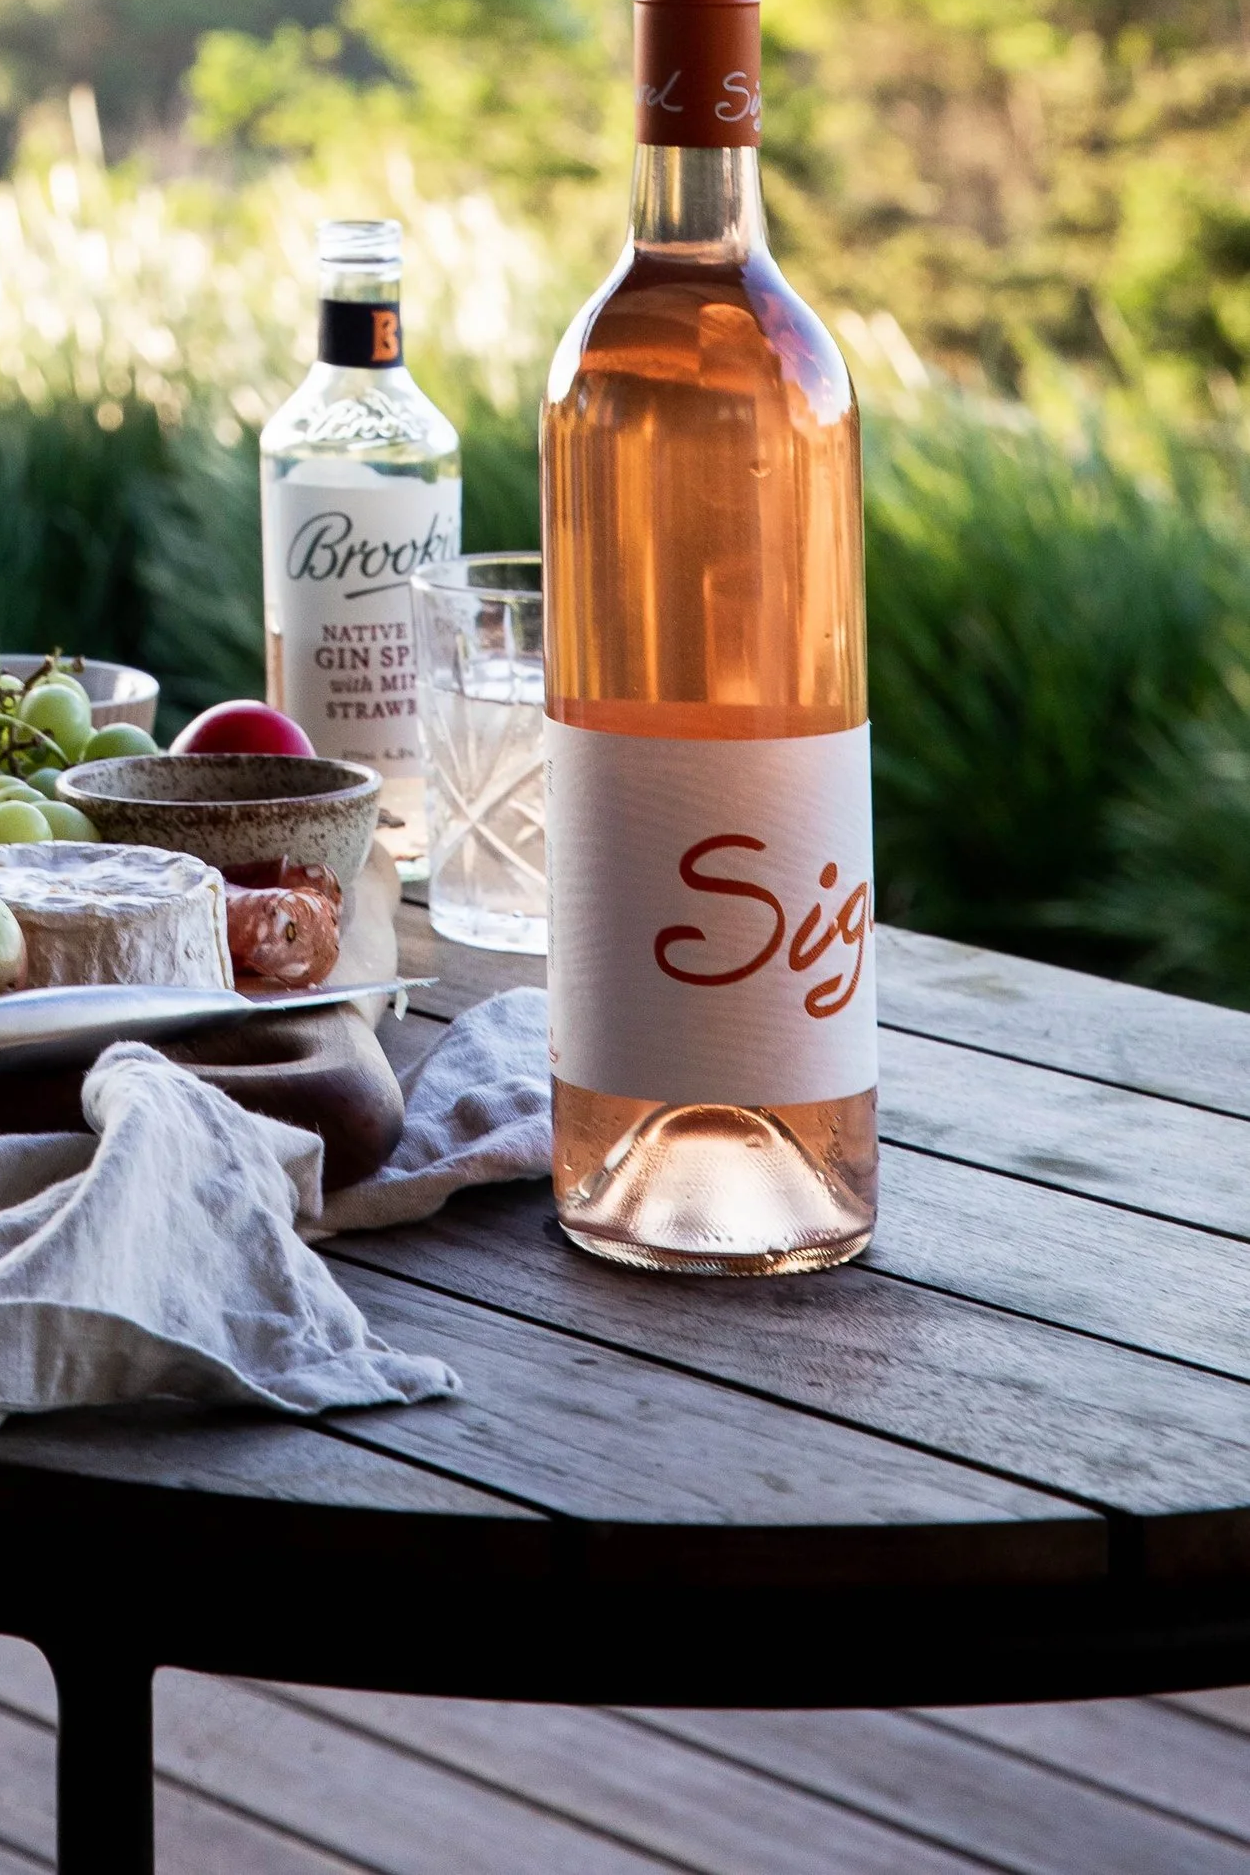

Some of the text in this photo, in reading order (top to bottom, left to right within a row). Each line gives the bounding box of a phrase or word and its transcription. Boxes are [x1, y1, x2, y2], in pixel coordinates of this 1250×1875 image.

[370, 309, 399, 362] B
[322, 622, 407, 642] NATIVE
[315, 644, 417, 670] GIN SP
[654, 833, 874, 1019] Sig
